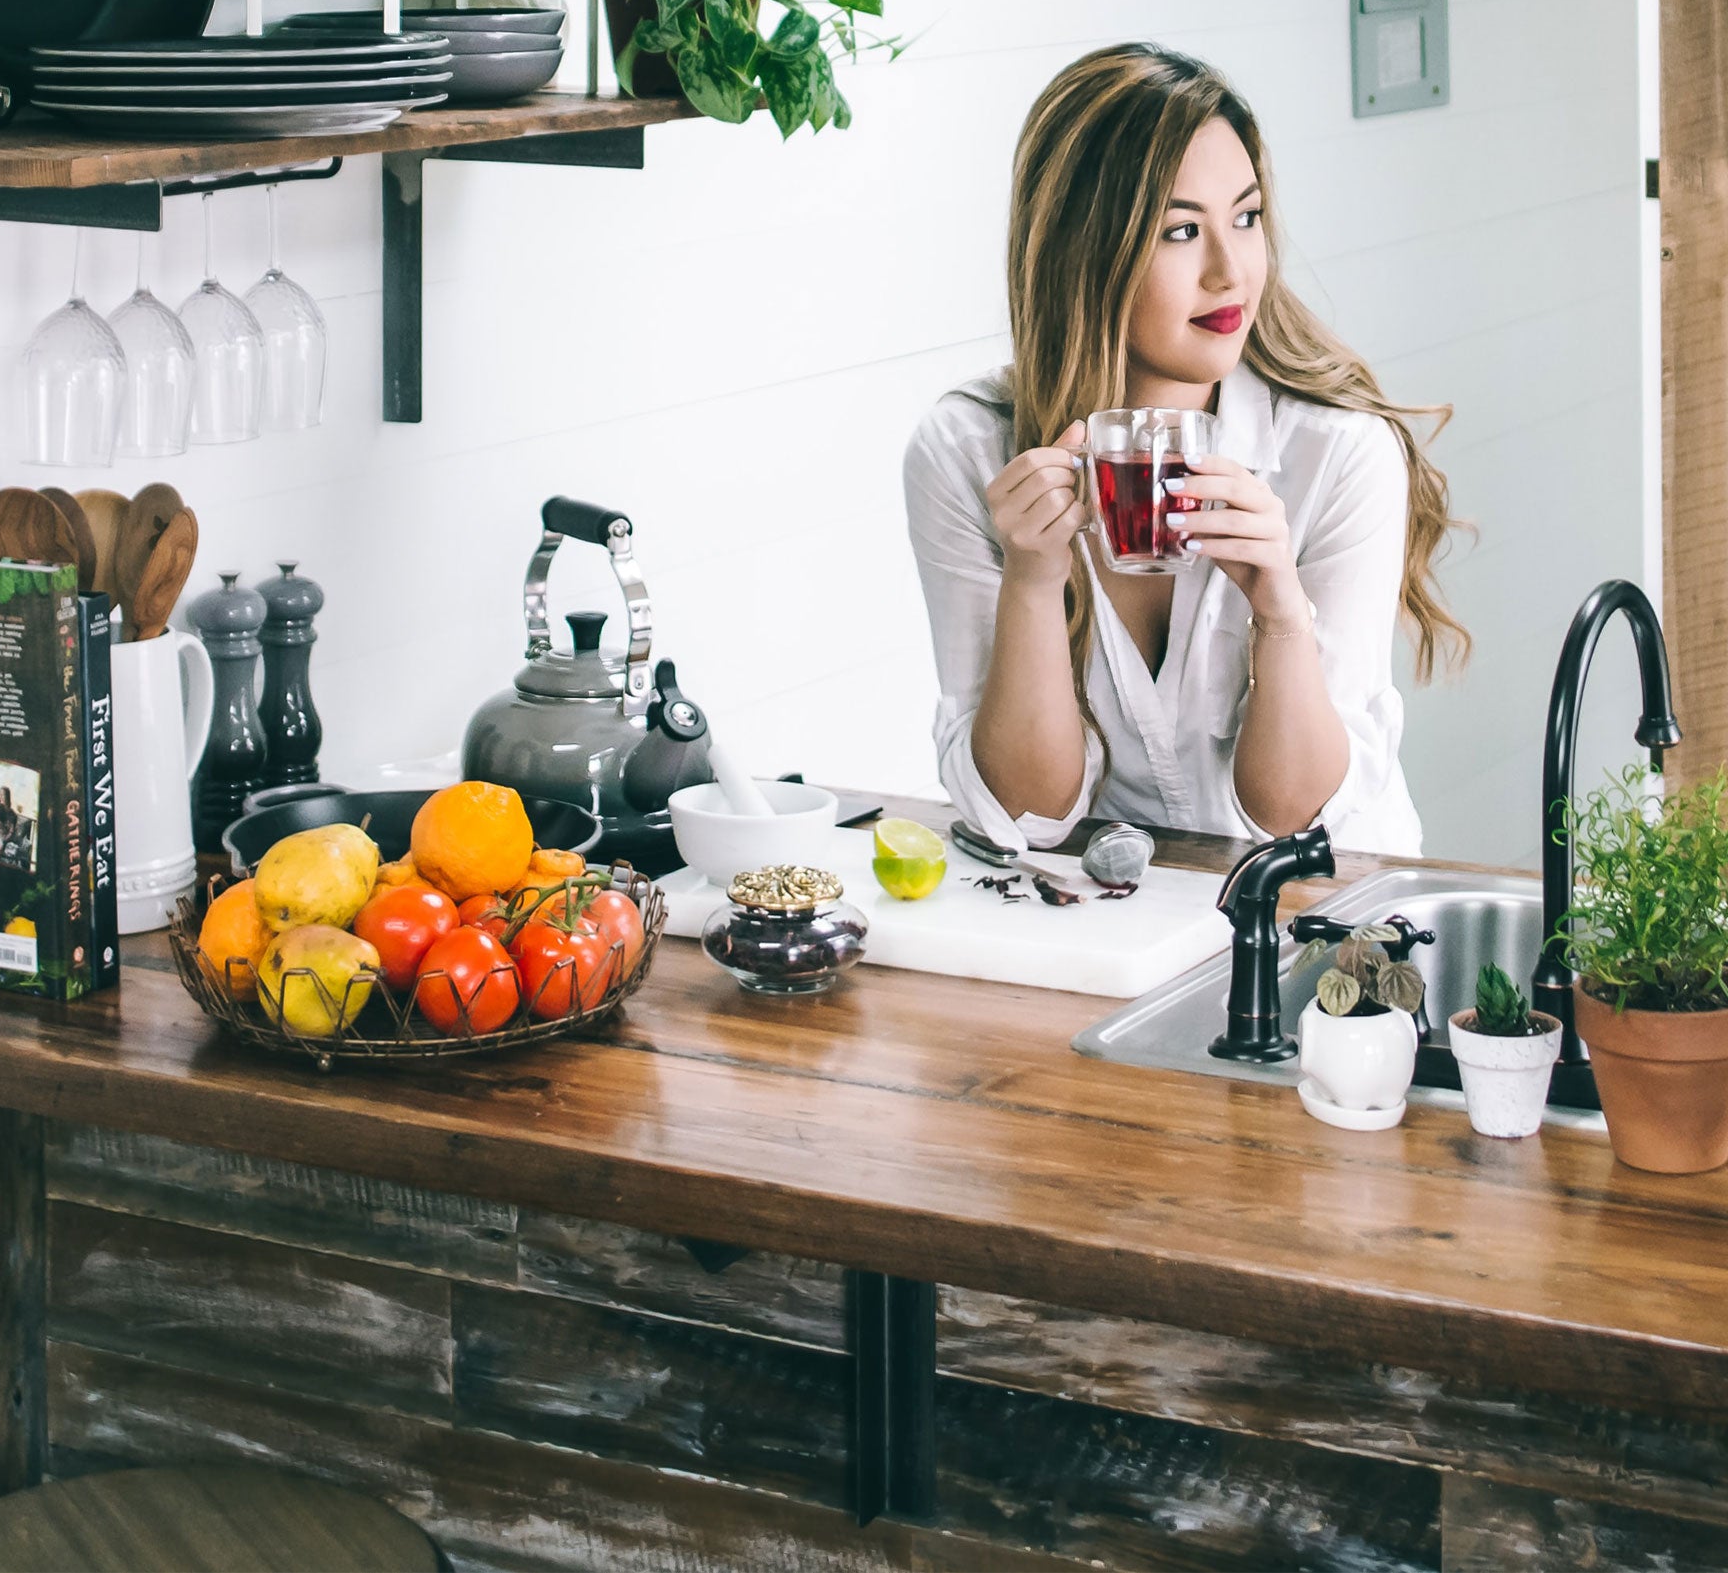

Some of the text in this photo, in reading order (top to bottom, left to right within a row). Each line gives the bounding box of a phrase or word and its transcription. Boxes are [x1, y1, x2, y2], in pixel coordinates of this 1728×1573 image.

[65, 799, 81, 921] GATHERINGS
[92, 693, 114, 889] First We Eat
